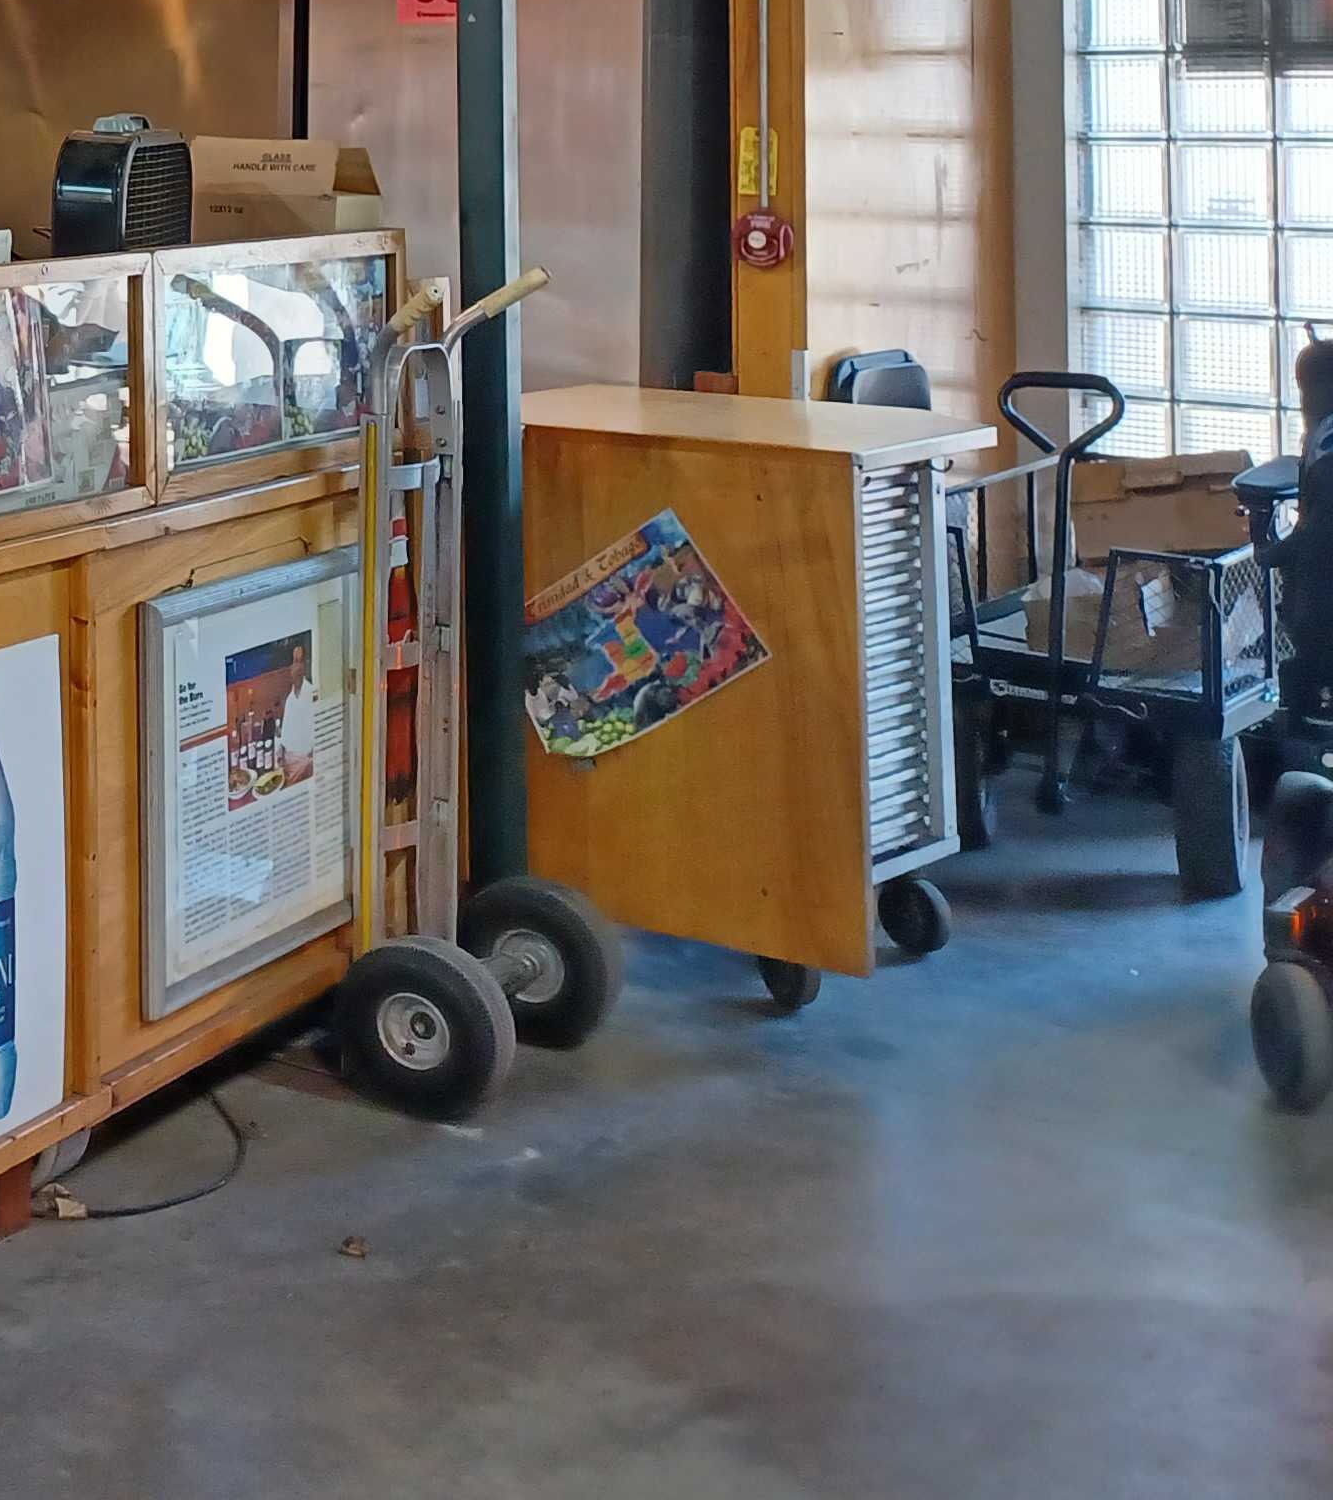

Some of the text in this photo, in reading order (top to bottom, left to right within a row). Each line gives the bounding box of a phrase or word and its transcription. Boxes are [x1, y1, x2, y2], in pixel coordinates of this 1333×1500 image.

[232, 163, 317, 172] HANDLE WITH CARE
